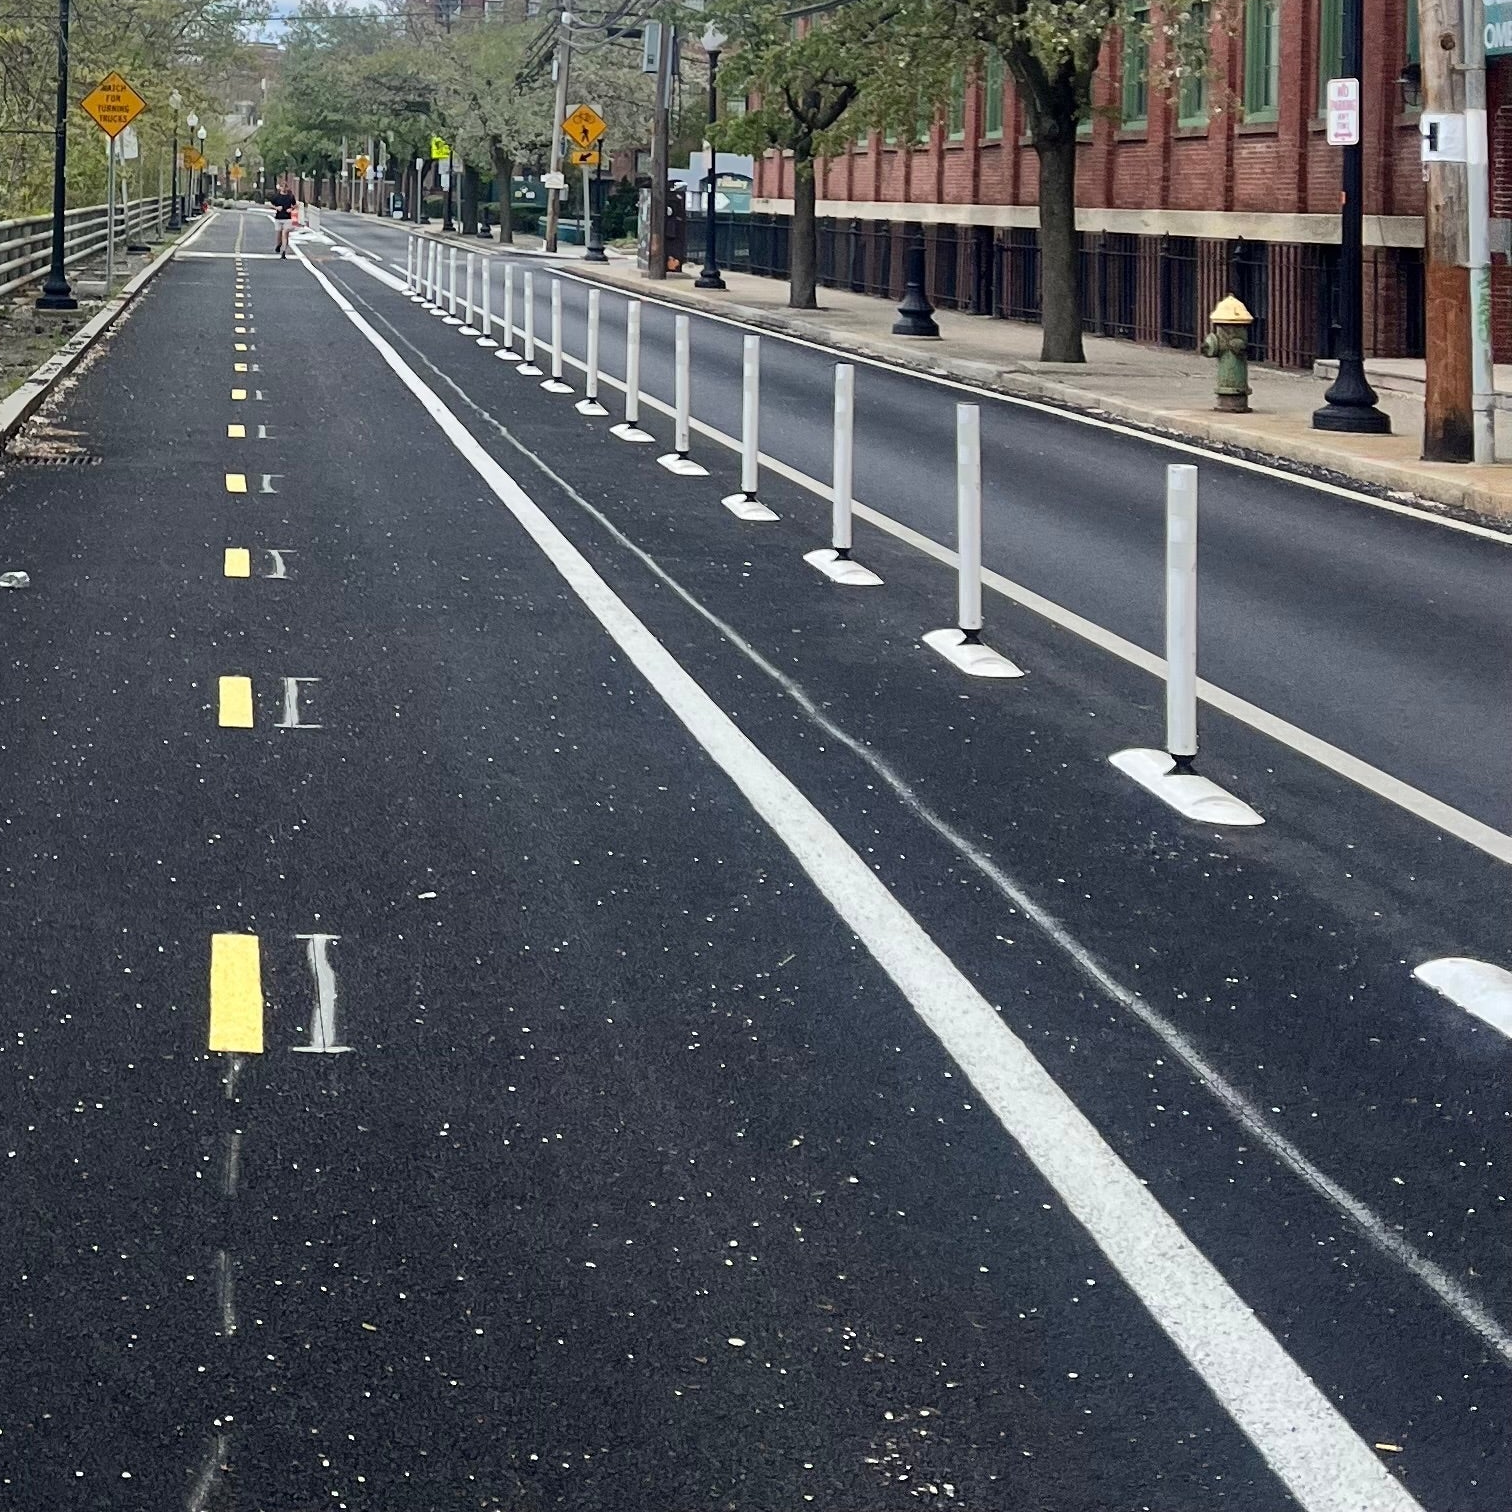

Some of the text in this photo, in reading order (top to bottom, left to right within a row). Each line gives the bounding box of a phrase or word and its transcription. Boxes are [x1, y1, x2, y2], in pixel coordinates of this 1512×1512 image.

[1337, 85, 1349, 97] NO
[106, 94, 121, 103] FOR
[97, 104, 130, 114] TURNING
[99, 114, 128, 123] TRUCKS
